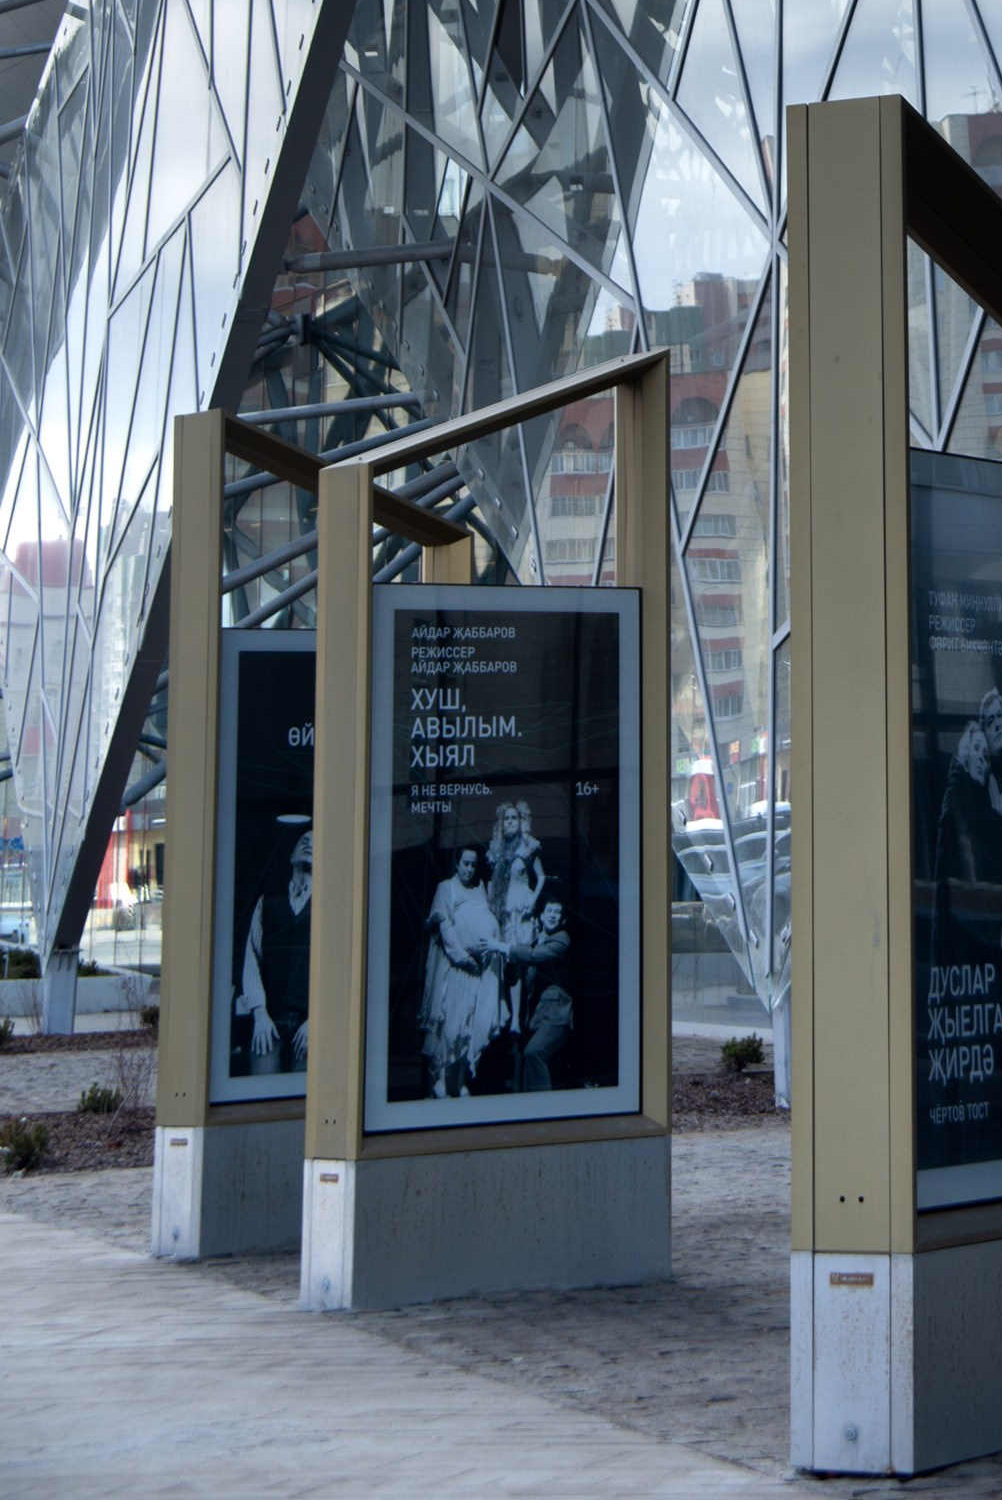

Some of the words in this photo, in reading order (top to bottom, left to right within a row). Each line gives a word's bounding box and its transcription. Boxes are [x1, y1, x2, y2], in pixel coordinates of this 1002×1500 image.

[928, 590, 958, 607] ТУФАН
[929, 615, 976, 633] РЕЖИССЕР
[411, 626, 451, 640] АЙДАР
[411, 646, 475, 659] РЕЖИССЕР
[411, 660, 451, 675] АЙДАР
[411, 688, 467, 713] ХУШ,
[410, 715, 523, 739] АВЫЛЫМ.
[410, 744, 475, 767] ХЫЯЛ
[411, 784, 419, 797] Я
[422, 784, 436, 797] НЕ
[439, 783, 493, 797] ВЕРНУСЬ.
[575, 781, 599, 796] 16+
[411, 801, 452, 814] МЕЧТЫ
[928, 963, 995, 1004] ДУСЛАР
[928, 1043, 995, 1086] ҖИРДӘ
[966, 1101, 990, 1120] ТОСТ
